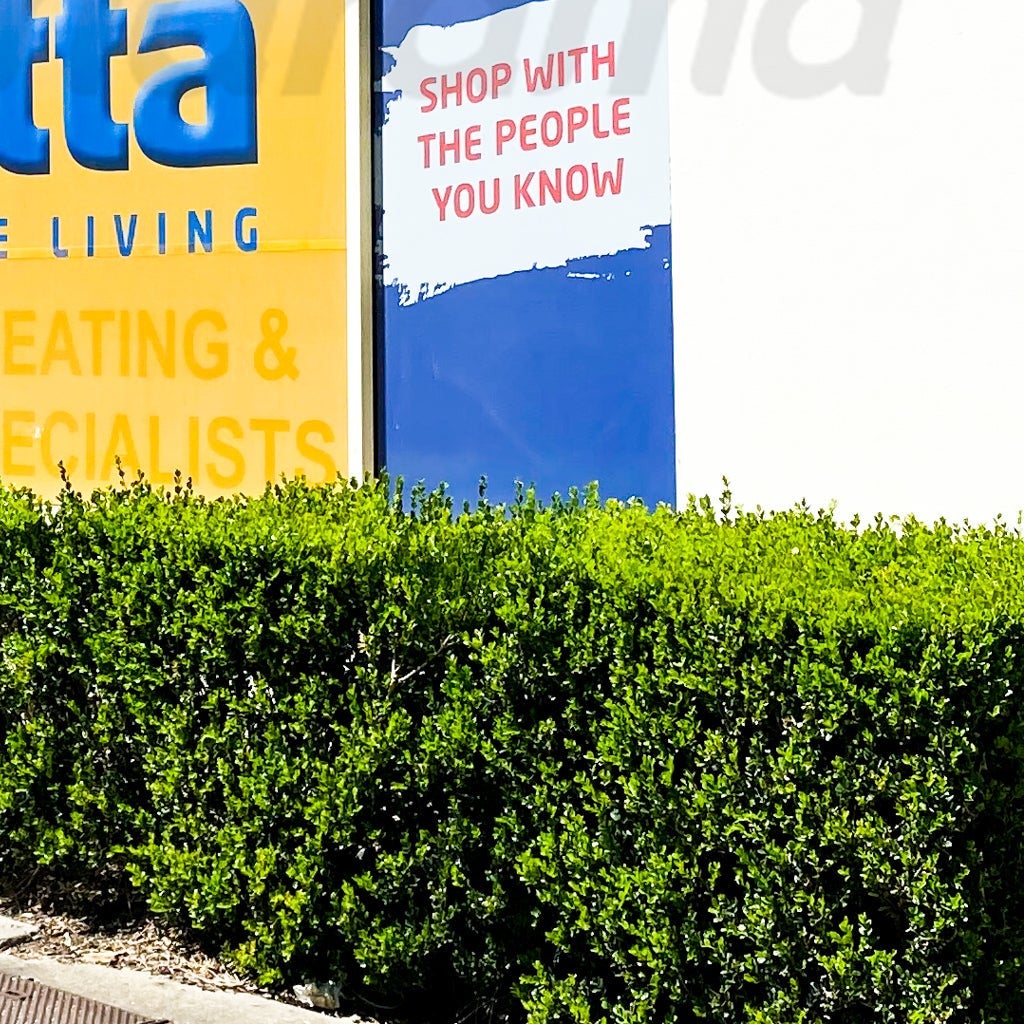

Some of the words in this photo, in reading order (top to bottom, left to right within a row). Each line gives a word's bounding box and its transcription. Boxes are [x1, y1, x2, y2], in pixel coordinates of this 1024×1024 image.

[419, 62, 512, 113] SHOP
[523, 41, 616, 93] WITH
[417, 125, 482, 169] THE
[496, 98, 631, 155] PEOPLE
[432, 178, 501, 222] YOU
[514, 158, 625, 209] KNOW
[52, 207, 258, 258] LIVING
[254, 308, 301, 381] &
